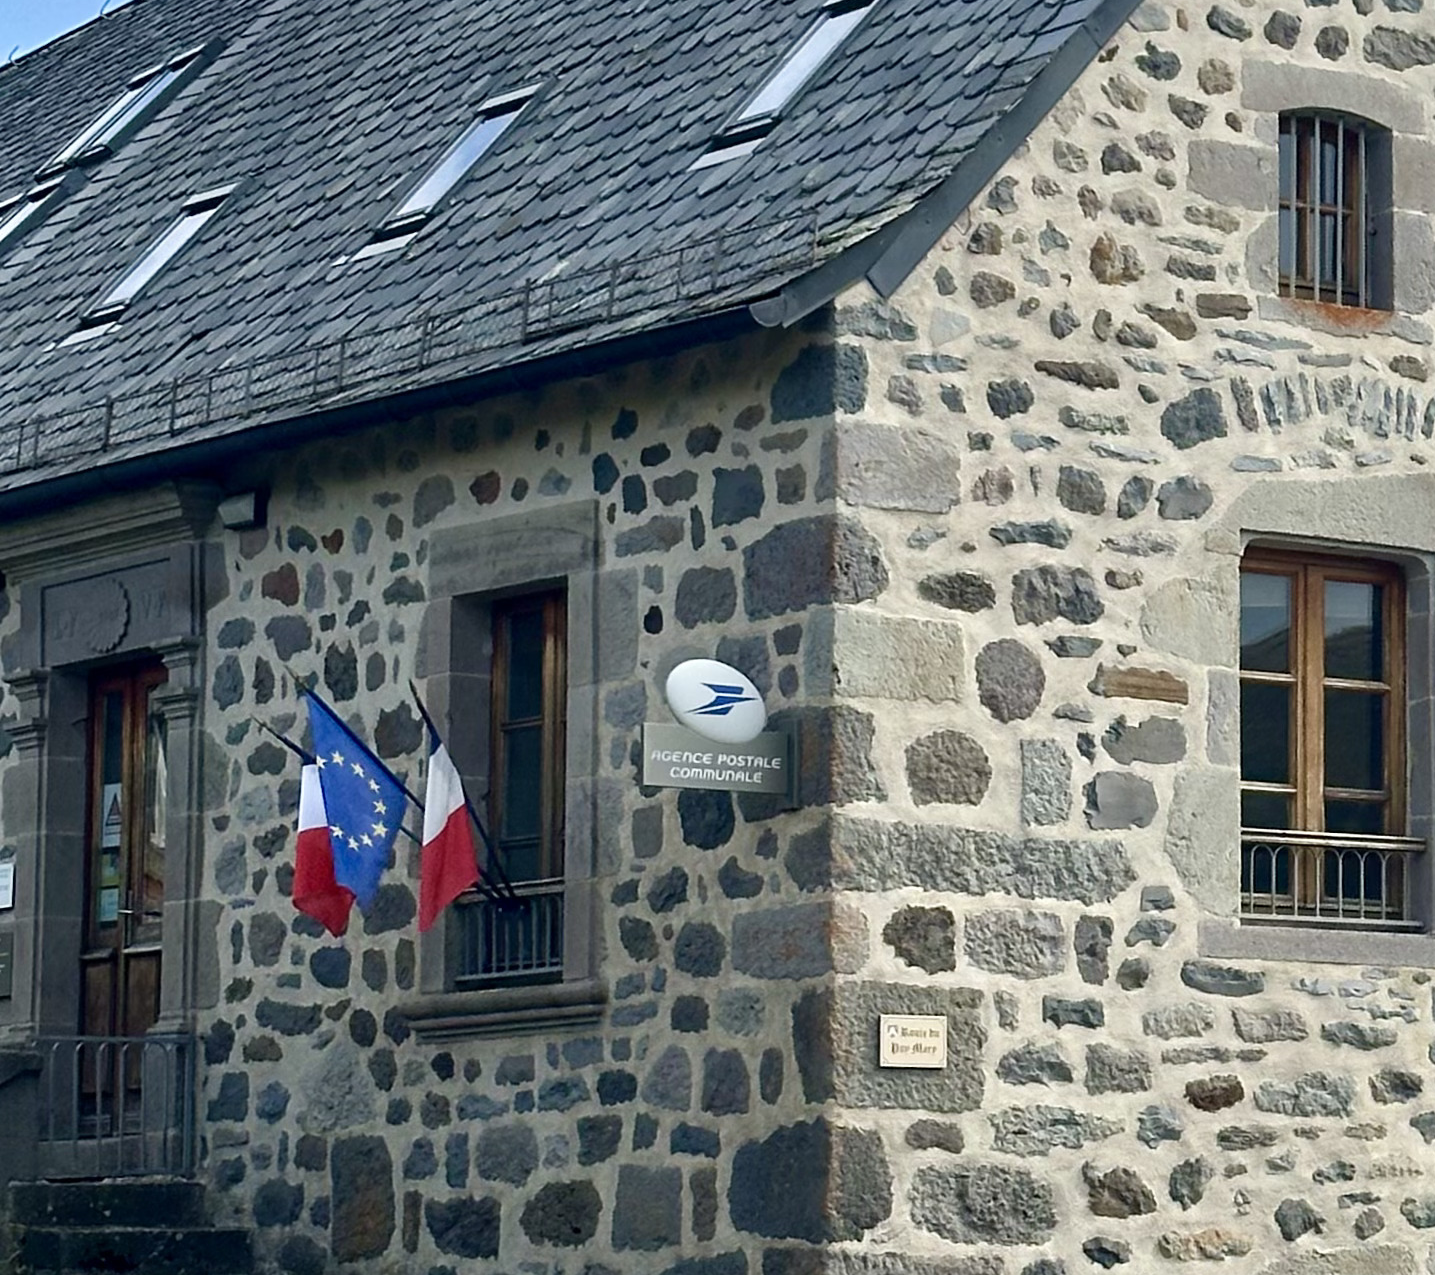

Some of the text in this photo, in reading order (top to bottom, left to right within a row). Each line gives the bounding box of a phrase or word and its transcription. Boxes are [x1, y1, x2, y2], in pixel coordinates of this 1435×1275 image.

[651, 749, 782, 770] AGENCE POSTALE
[669, 766, 763, 784] COMMUNALE
